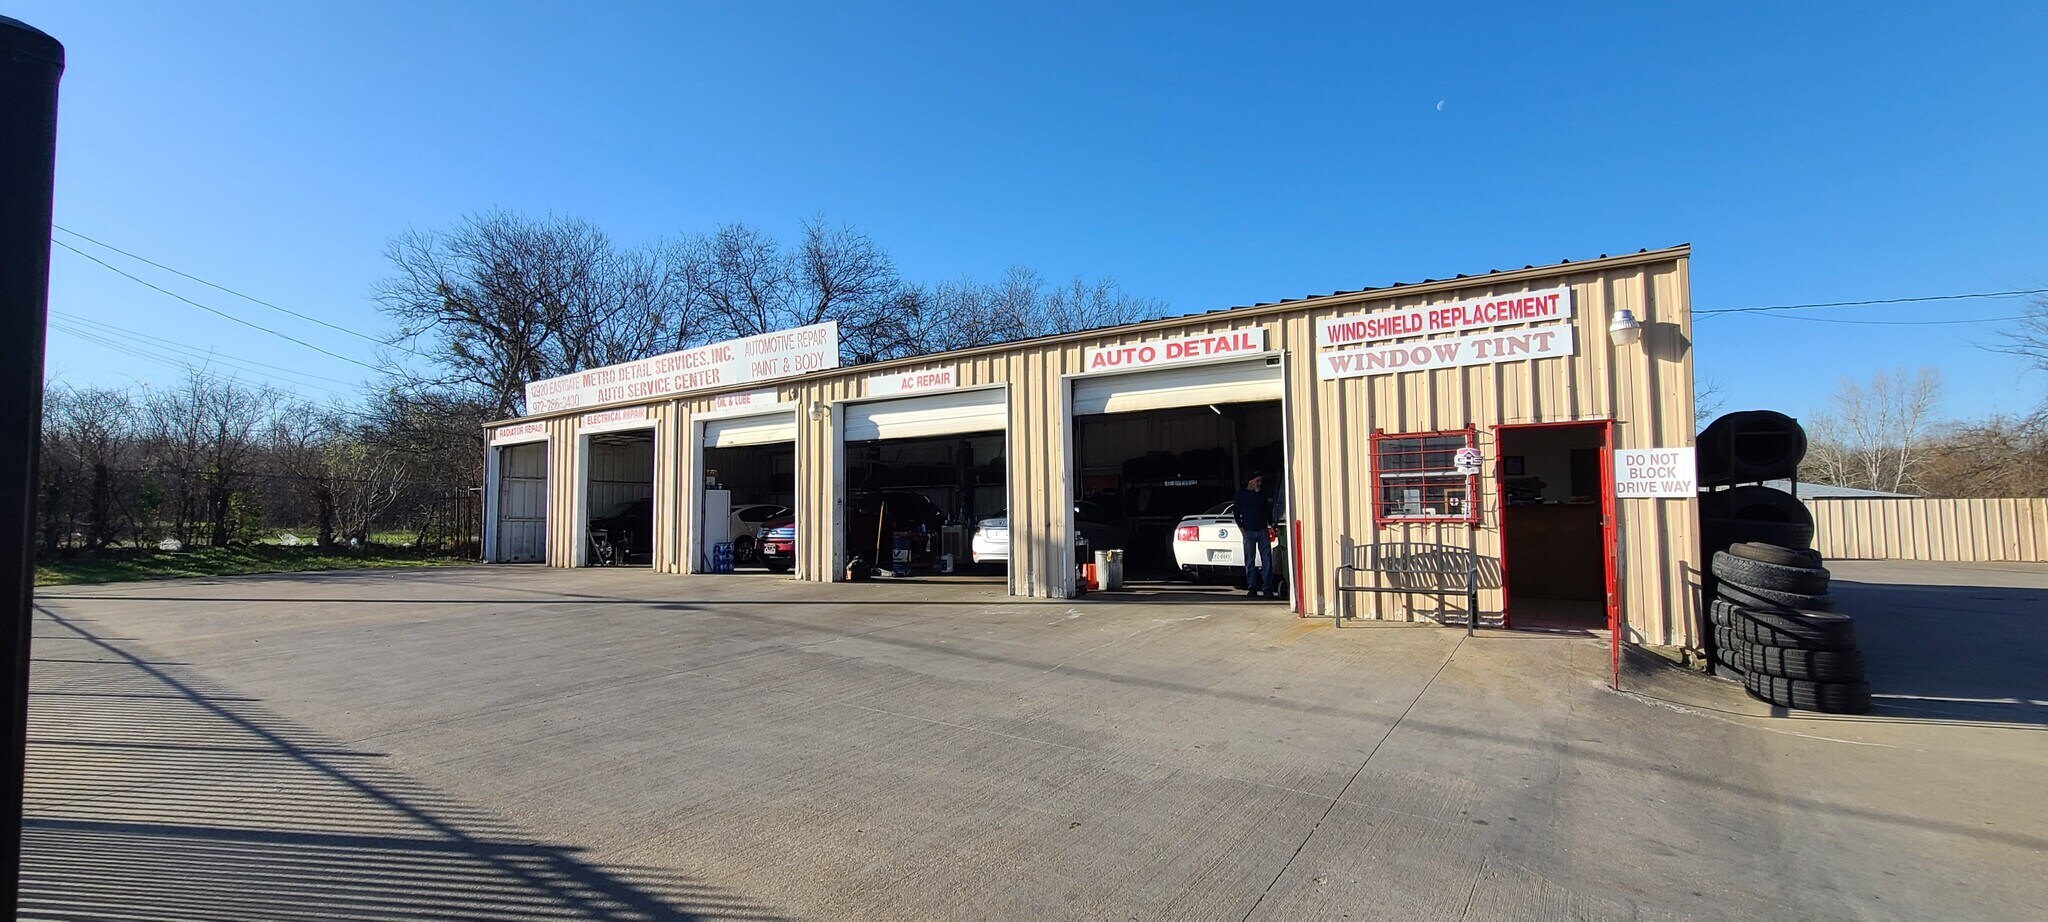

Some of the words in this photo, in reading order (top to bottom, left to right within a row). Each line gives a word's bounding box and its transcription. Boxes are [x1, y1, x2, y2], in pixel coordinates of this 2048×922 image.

[1327, 313, 1423, 343] WINDSHIELD
[1429, 293, 1560, 330] REPLACEMENT
[745, 333, 794, 357] AUTOMOTIVE
[797, 328, 827, 348] REPAIR
[1091, 346, 1156, 368] AUTO
[1166, 333, 1257, 360] DETAIL
[1328, 342, 1461, 374] WINDOW
[1470, 331, 1555, 359] TINT
[582, 369, 615, 388] METRO
[618, 363, 651, 380] DETAIL
[711, 345, 735, 363] INC.
[751, 358, 778, 378] PAINT
[783, 357, 790, 373] &
[795, 351, 824, 371] BODY
[549, 375, 580, 394] EASTGATE
[598, 386, 624, 403] AUTO
[627, 377, 671, 398] SERVICE
[674, 368, 720, 391] CENTER
[901, 377, 914, 390] AC
[916, 372, 951, 388] REPAIR
[717, 397, 727, 408] OIL
[728, 396, 733, 406] &
[735, 394, 751, 406] LUBE
[587, 413, 622, 425] ELECTRICAL
[622, 409, 645, 421] REPAIR
[500, 428, 523, 438] RADIATOR
[524, 424, 543, 434] REPAIR
[1626, 454, 1645, 466] DO
[1650, 453, 1679, 465] NOT
[1629, 467, 1676, 479] BLOCK
[1617, 482, 1657, 494] DRIVE
[1662, 481, 1691, 493] WAY
